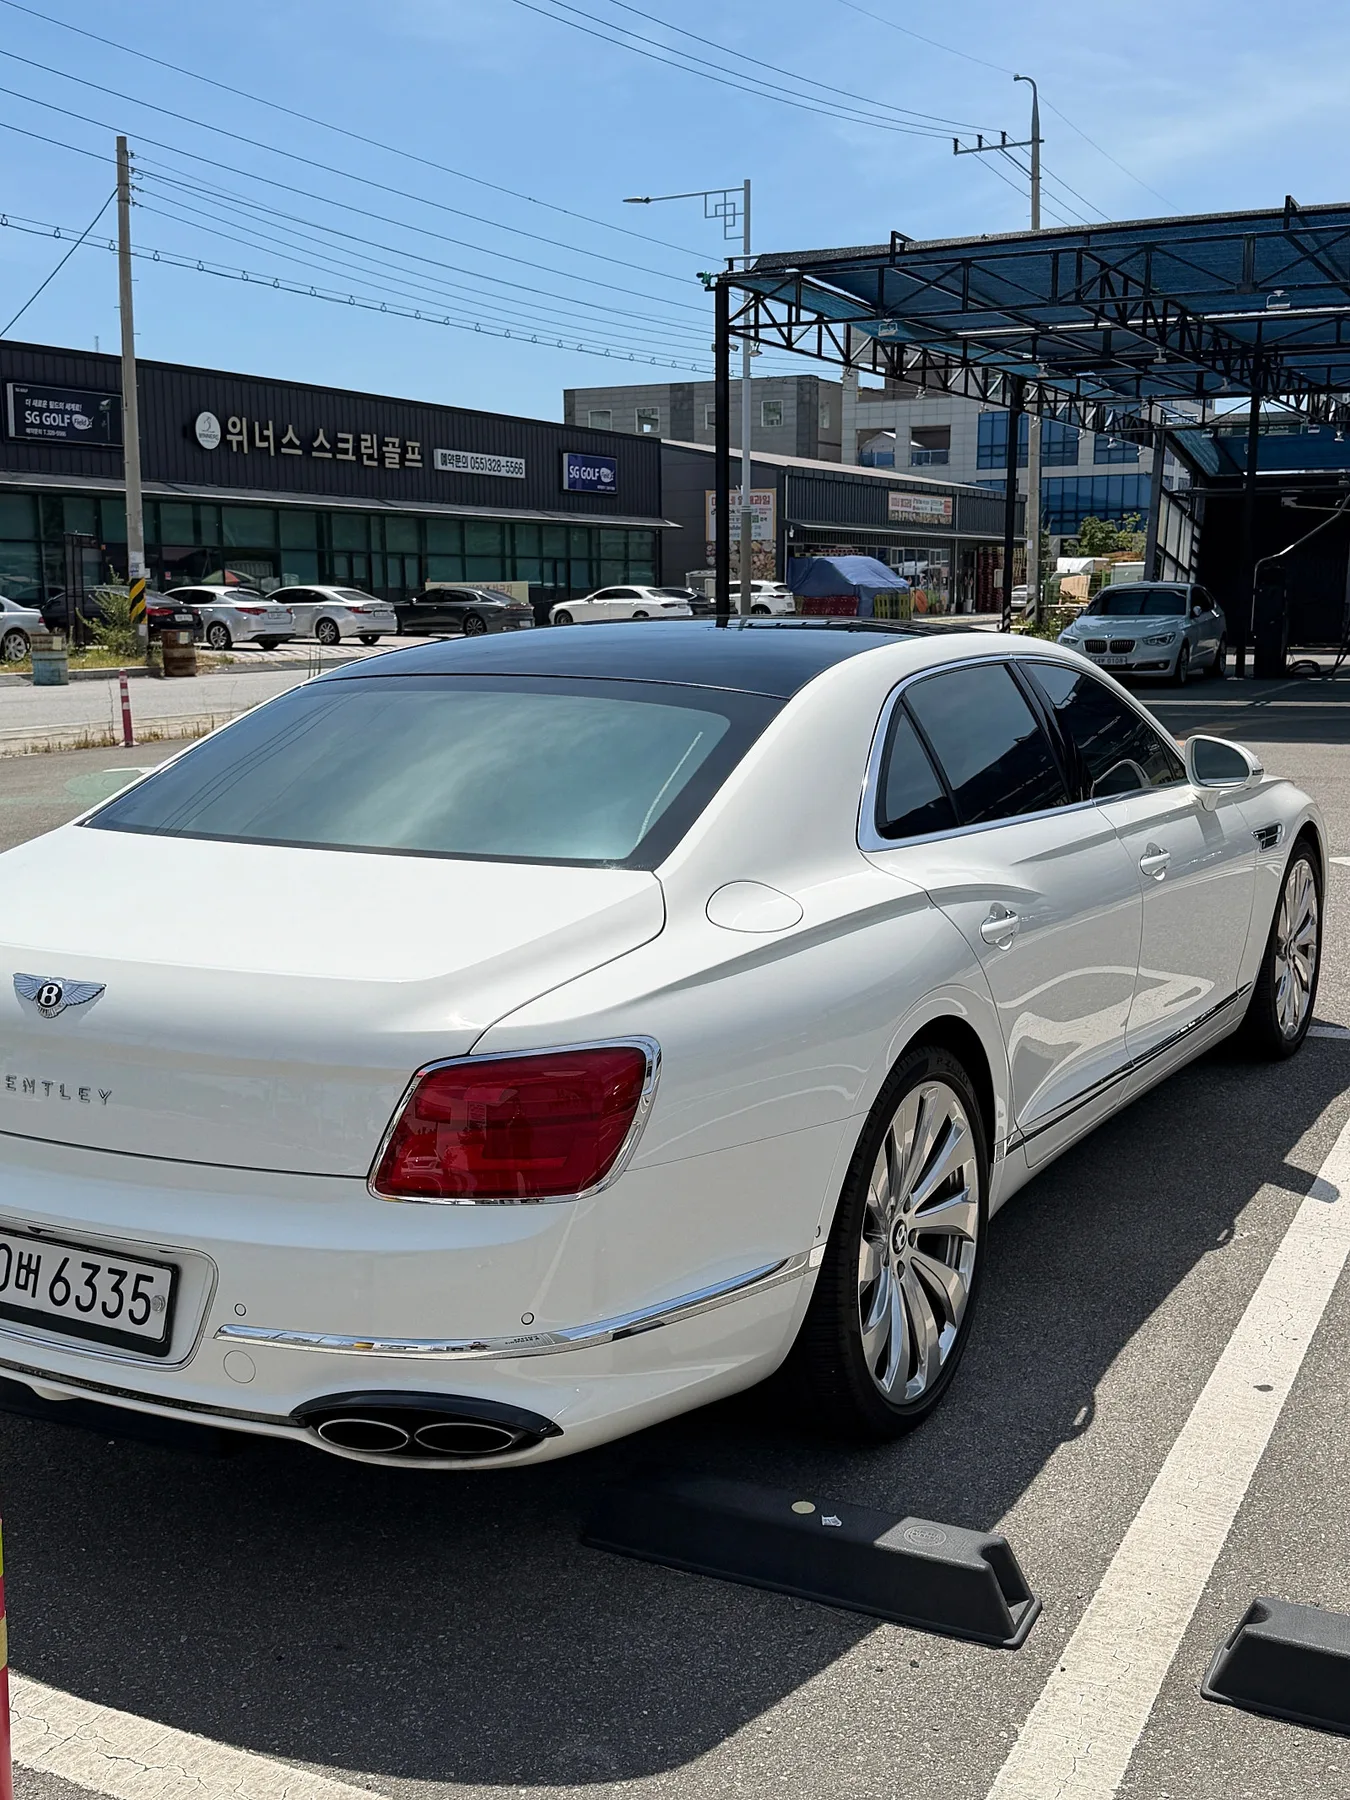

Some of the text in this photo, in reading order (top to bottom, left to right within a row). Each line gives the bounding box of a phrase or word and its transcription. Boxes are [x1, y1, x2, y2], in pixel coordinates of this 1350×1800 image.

[25, 411, 40, 424] SG
[42, 412, 71, 427] GOLF
[226, 416, 423, 469] 위너스 스크린골프
[440, 453, 524, 475] 예약문의 055)328-5566
[569, 465, 580, 479] SG
[581, 467, 600, 480] GOLF
[39, 985, 60, 1006] B
[49, 1257, 155, 1326] 6335
